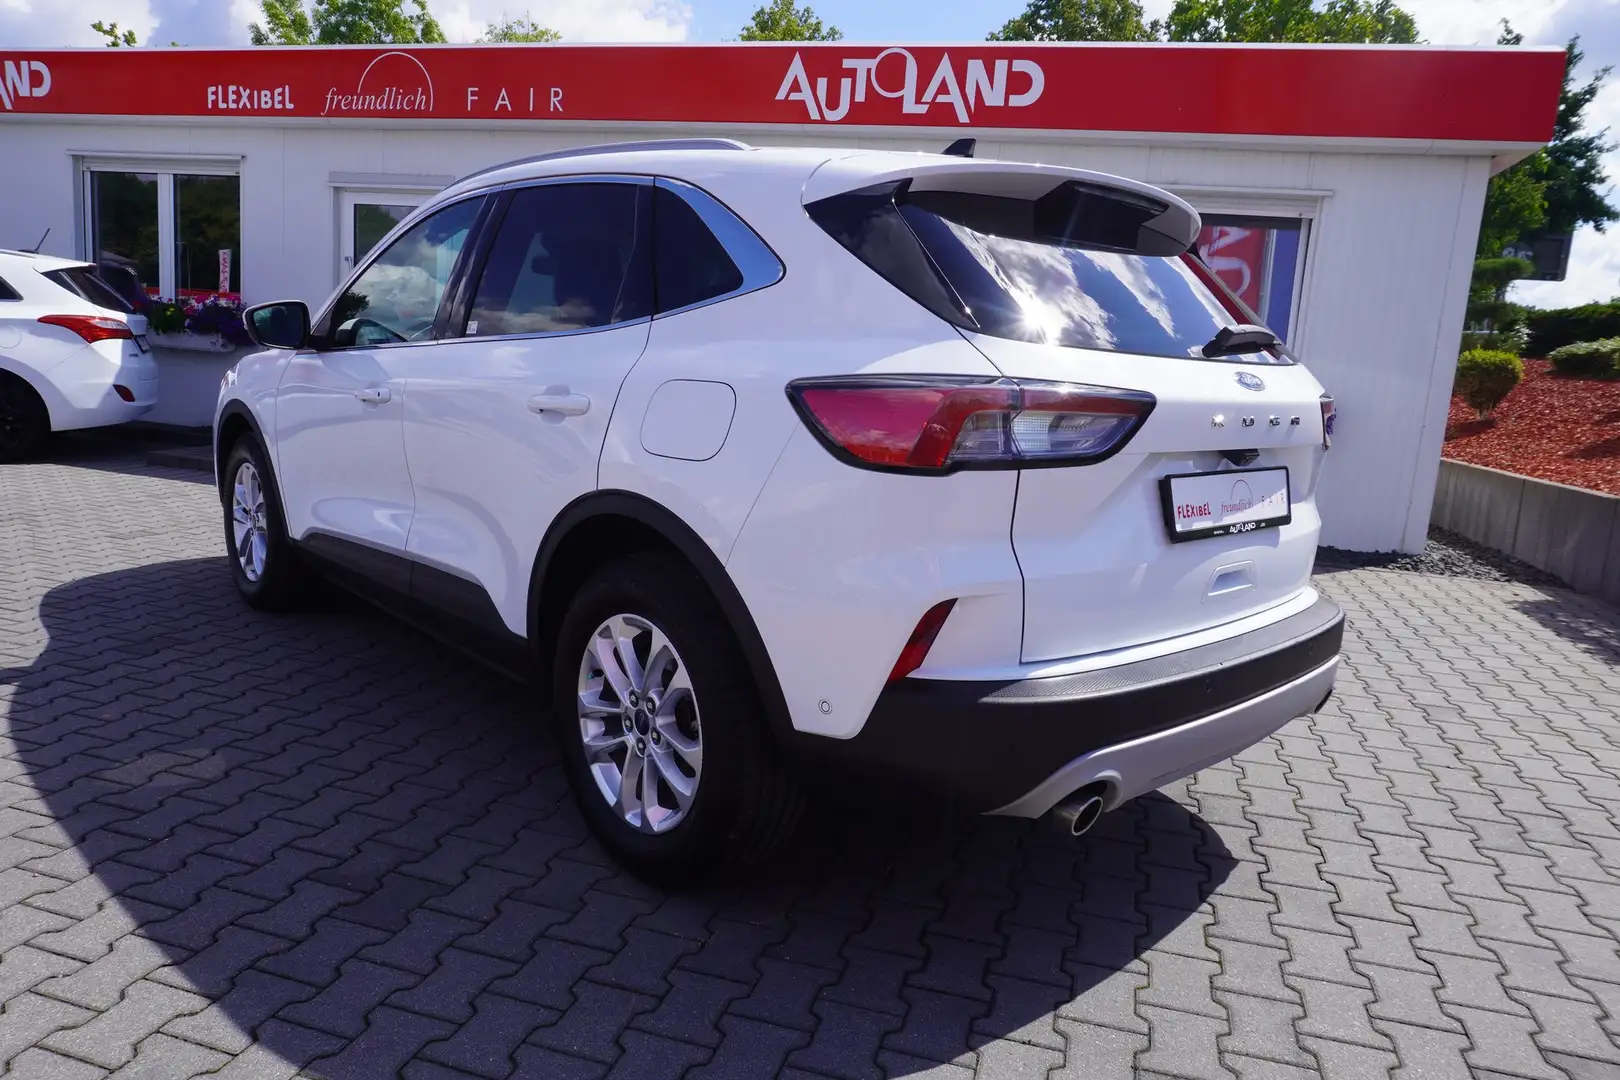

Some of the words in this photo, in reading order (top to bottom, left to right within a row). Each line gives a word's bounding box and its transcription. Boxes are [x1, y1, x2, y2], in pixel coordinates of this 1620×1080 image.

[207, 84, 294, 110] FLEXIBEL
[320, 86, 427, 115] freundlich
[467, 87, 563, 112] FAIR
[774, 47, 1045, 123] AUTOLAND
[1177, 501, 1212, 519] FLEXIBEL
